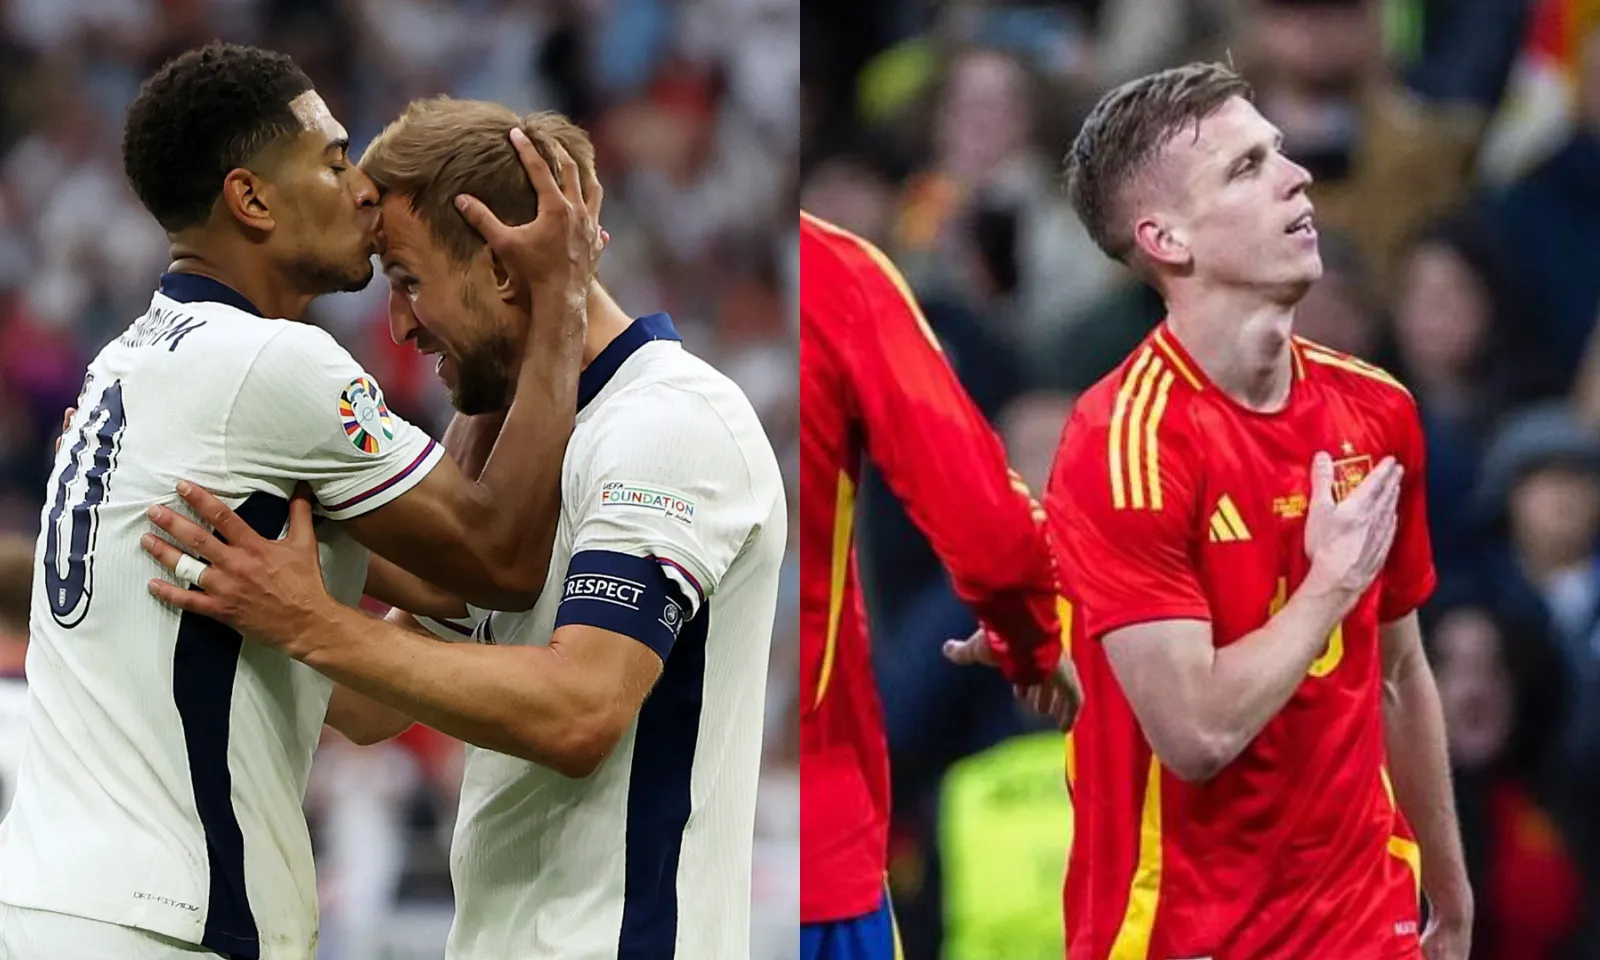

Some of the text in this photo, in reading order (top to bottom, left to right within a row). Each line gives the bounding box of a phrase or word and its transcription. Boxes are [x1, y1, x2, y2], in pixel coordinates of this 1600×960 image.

[602, 482, 624, 490] UEFA
[602, 491, 694, 517] FOUNDATION
[565, 578, 644, 604] RESPECT
